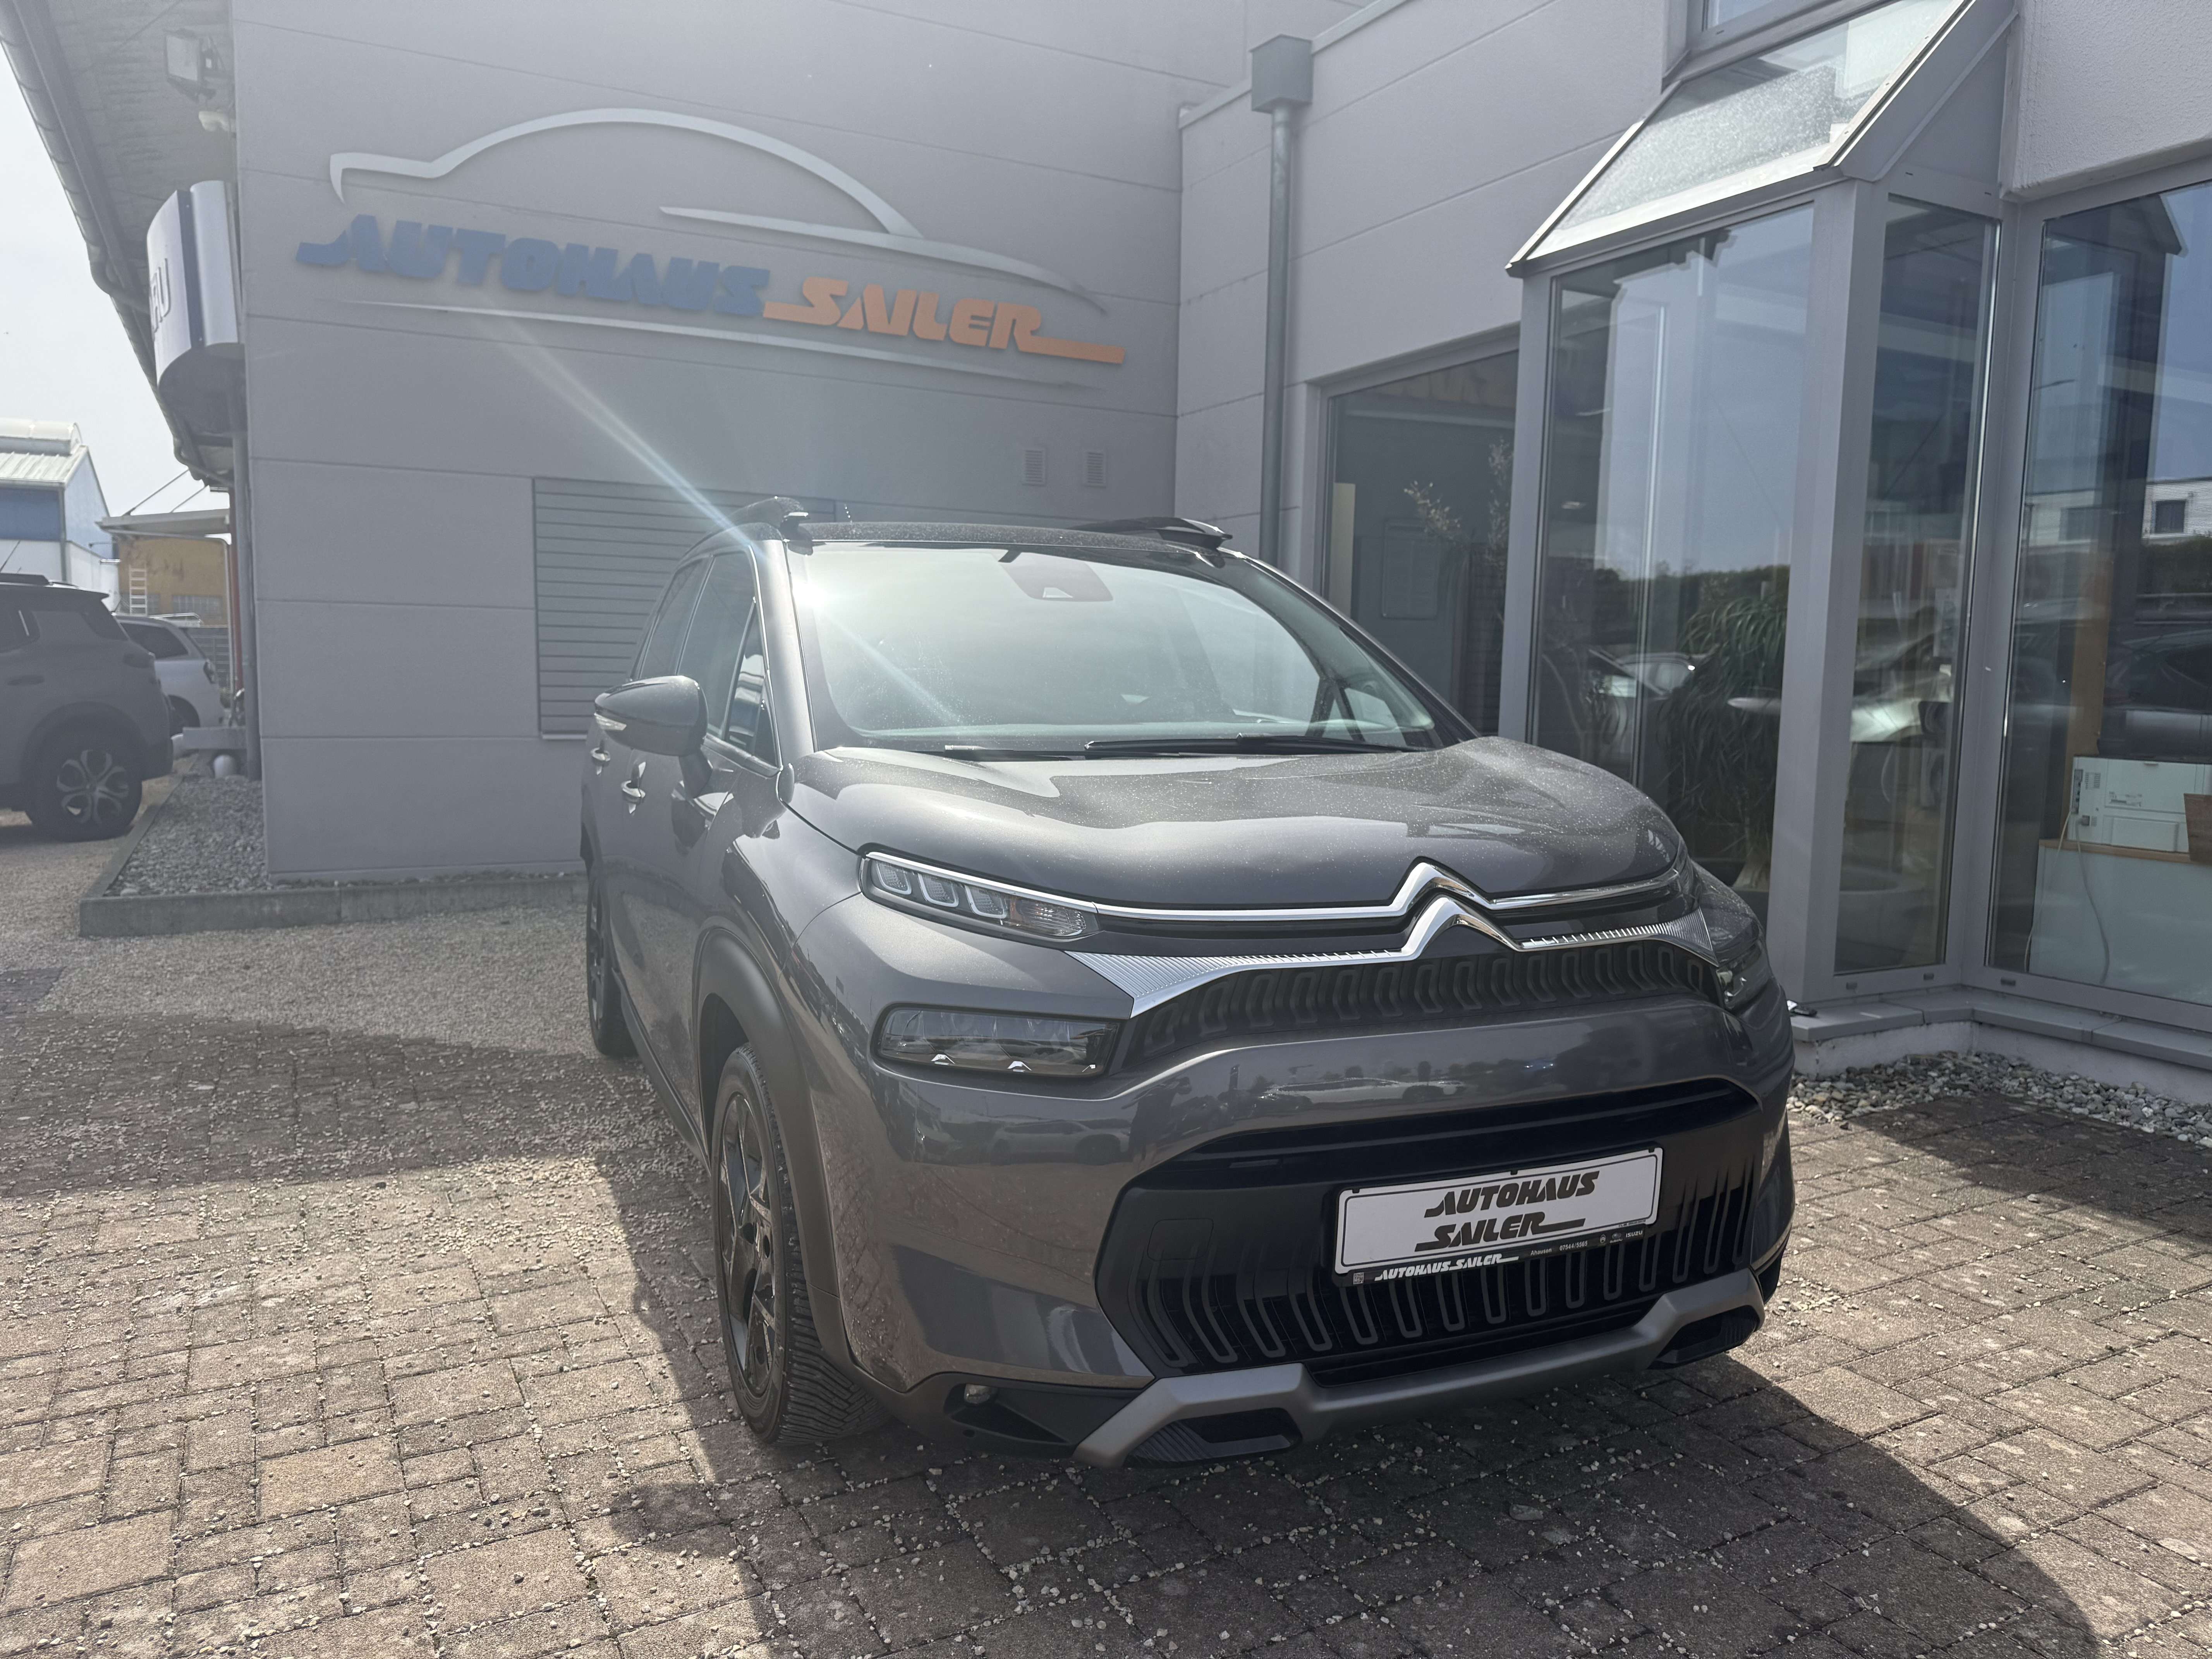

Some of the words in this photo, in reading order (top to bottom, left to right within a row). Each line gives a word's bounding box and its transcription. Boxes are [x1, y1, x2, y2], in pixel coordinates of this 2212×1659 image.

[296, 214, 770, 317] AUTOHAUS
[763, 276, 1125, 364] SAILER
[1424, 1171, 1600, 1218] AUTOHAUS
[1415, 1212, 1586, 1252] SAILER
[1530, 1248, 1552, 1256] Ahausen
[1374, 1261, 1451, 1281] AUTOHAUS
[1449, 1253, 1519, 1271] SAILER
